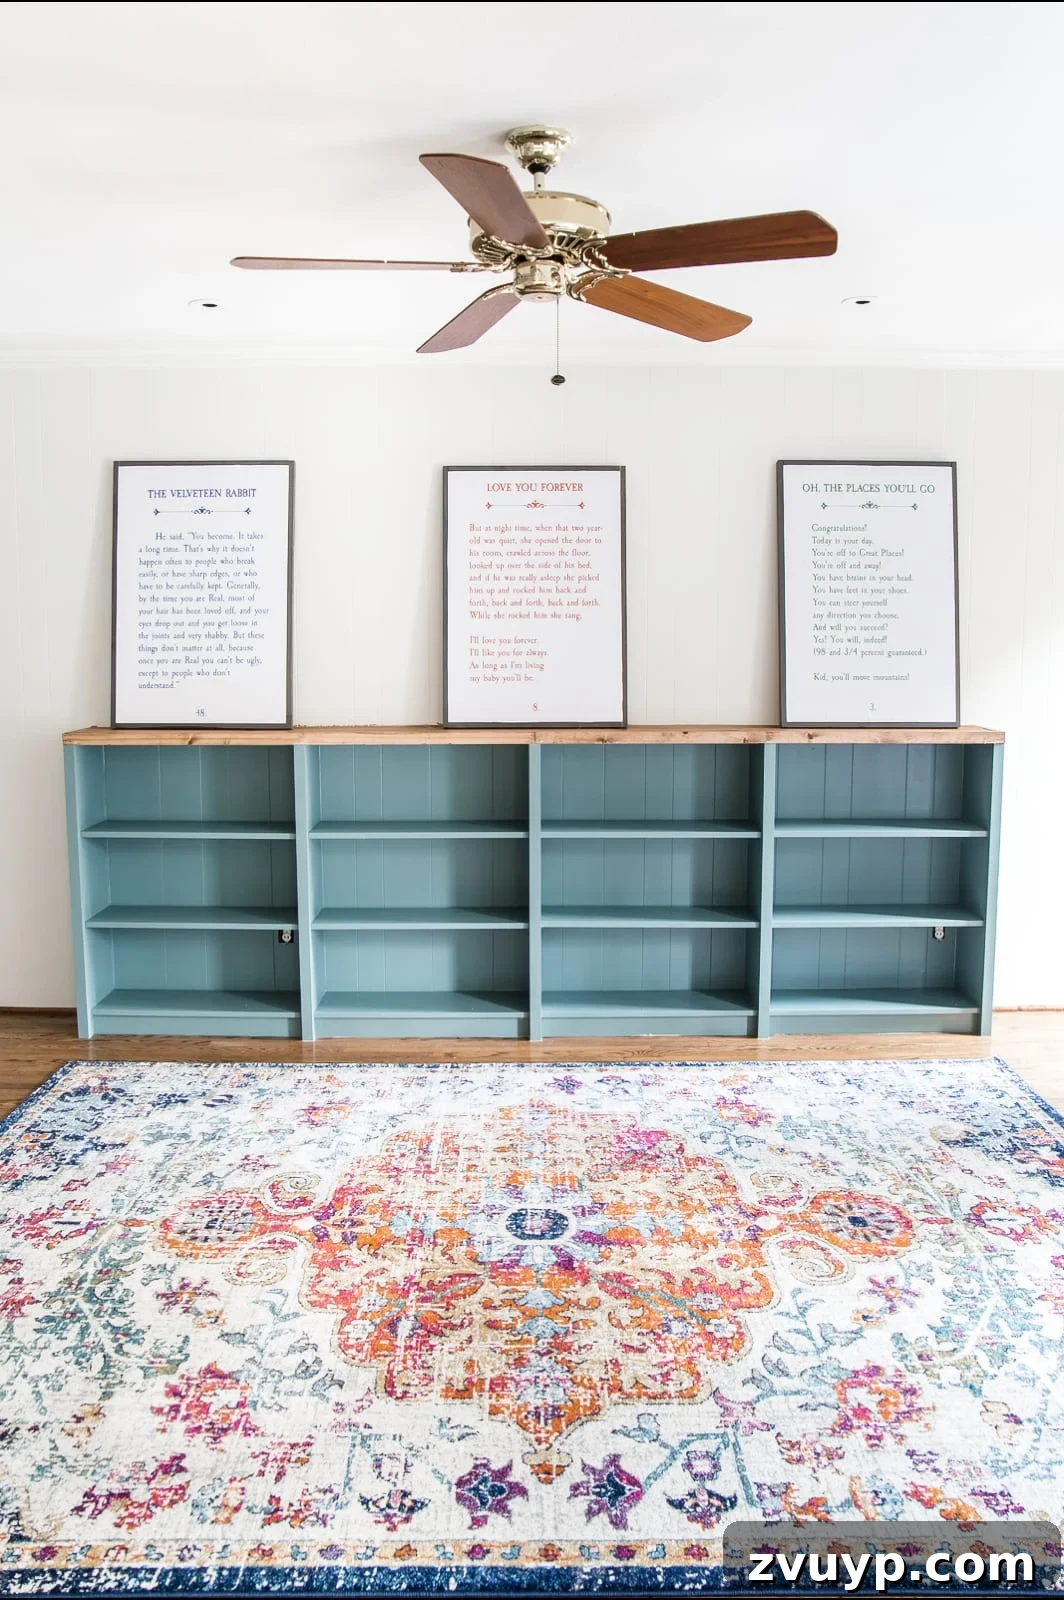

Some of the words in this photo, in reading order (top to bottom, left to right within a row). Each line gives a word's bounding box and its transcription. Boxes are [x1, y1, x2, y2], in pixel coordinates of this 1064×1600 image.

[487, 483, 512, 492] LOVE
[515, 483, 537, 492] YOU
[541, 483, 583, 492] FOREVER
[823, 484, 843, 492] THE
[846, 484, 881, 492] PLACES
[919, 484, 936, 494] GO
[147, 490, 167, 498] THE
[170, 489, 222, 498] VELVETEEN
[226, 488, 256, 498] RABBIT
